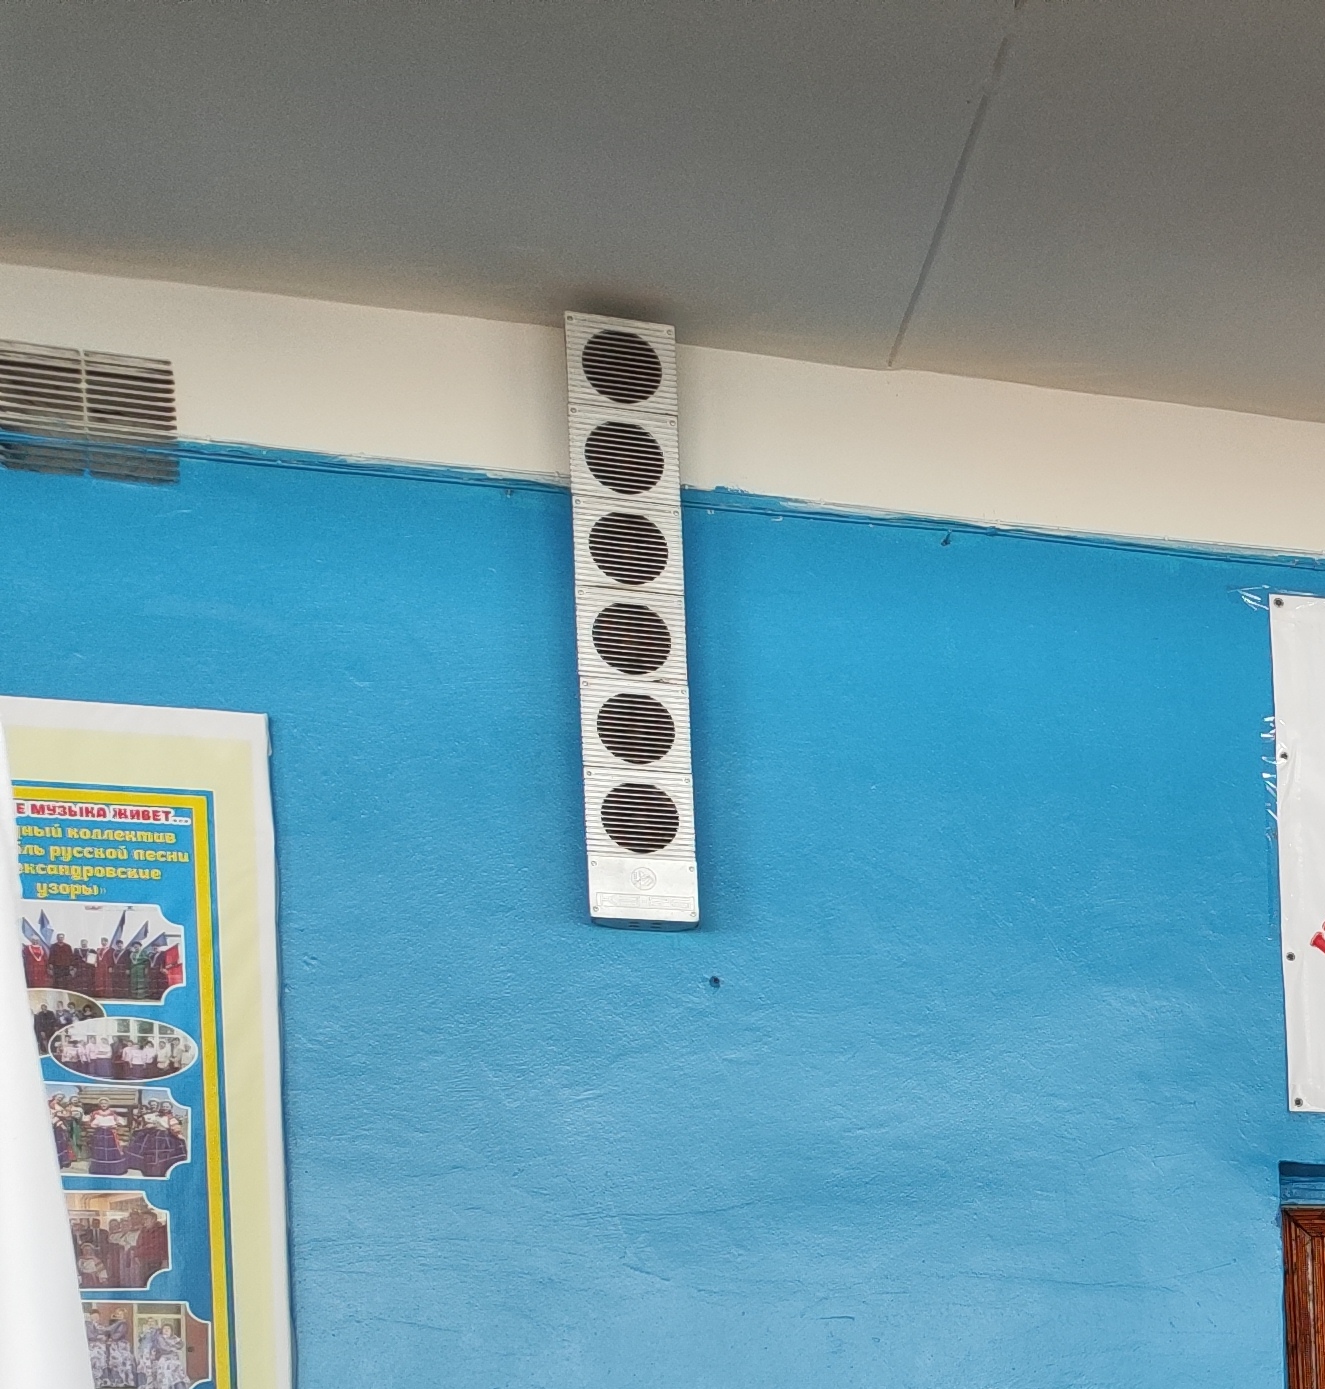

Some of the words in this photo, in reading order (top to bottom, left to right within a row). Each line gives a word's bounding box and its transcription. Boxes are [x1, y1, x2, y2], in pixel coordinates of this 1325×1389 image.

[30, 803, 108, 819] МУЗЫКА
[67, 827, 177, 844] коллектив
[50, 845, 128, 862] русской
[133, 850, 190, 863] песни
